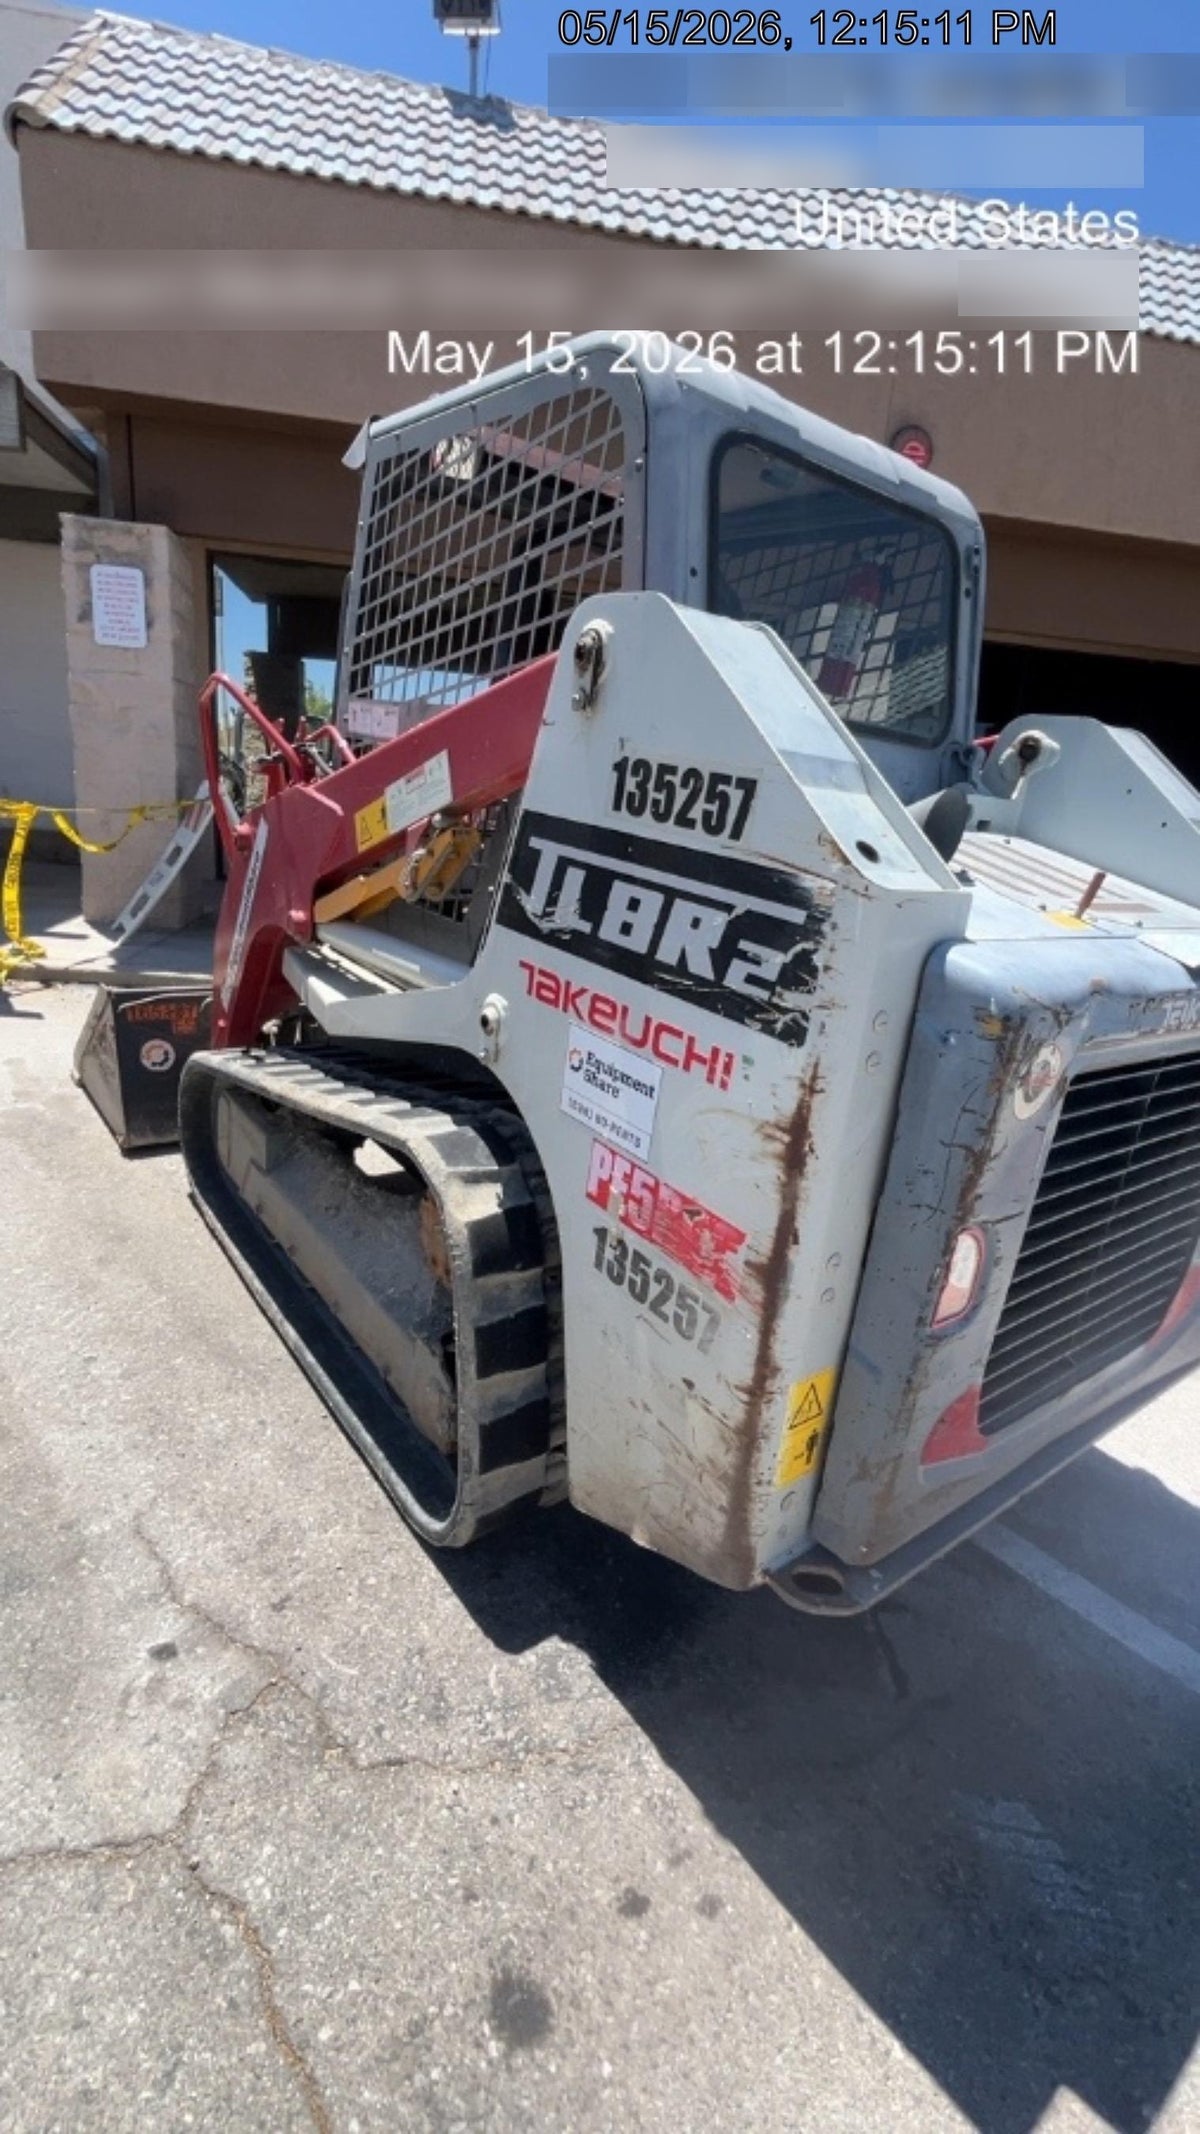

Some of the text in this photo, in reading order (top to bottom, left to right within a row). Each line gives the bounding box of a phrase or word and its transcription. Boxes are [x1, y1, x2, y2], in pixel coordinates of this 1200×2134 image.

[612, 756, 758, 842] 135257
[583, 1068, 620, 1099] Share
[585, 1050, 656, 1100] Equipment
[592, 1225, 722, 1354] 135257
